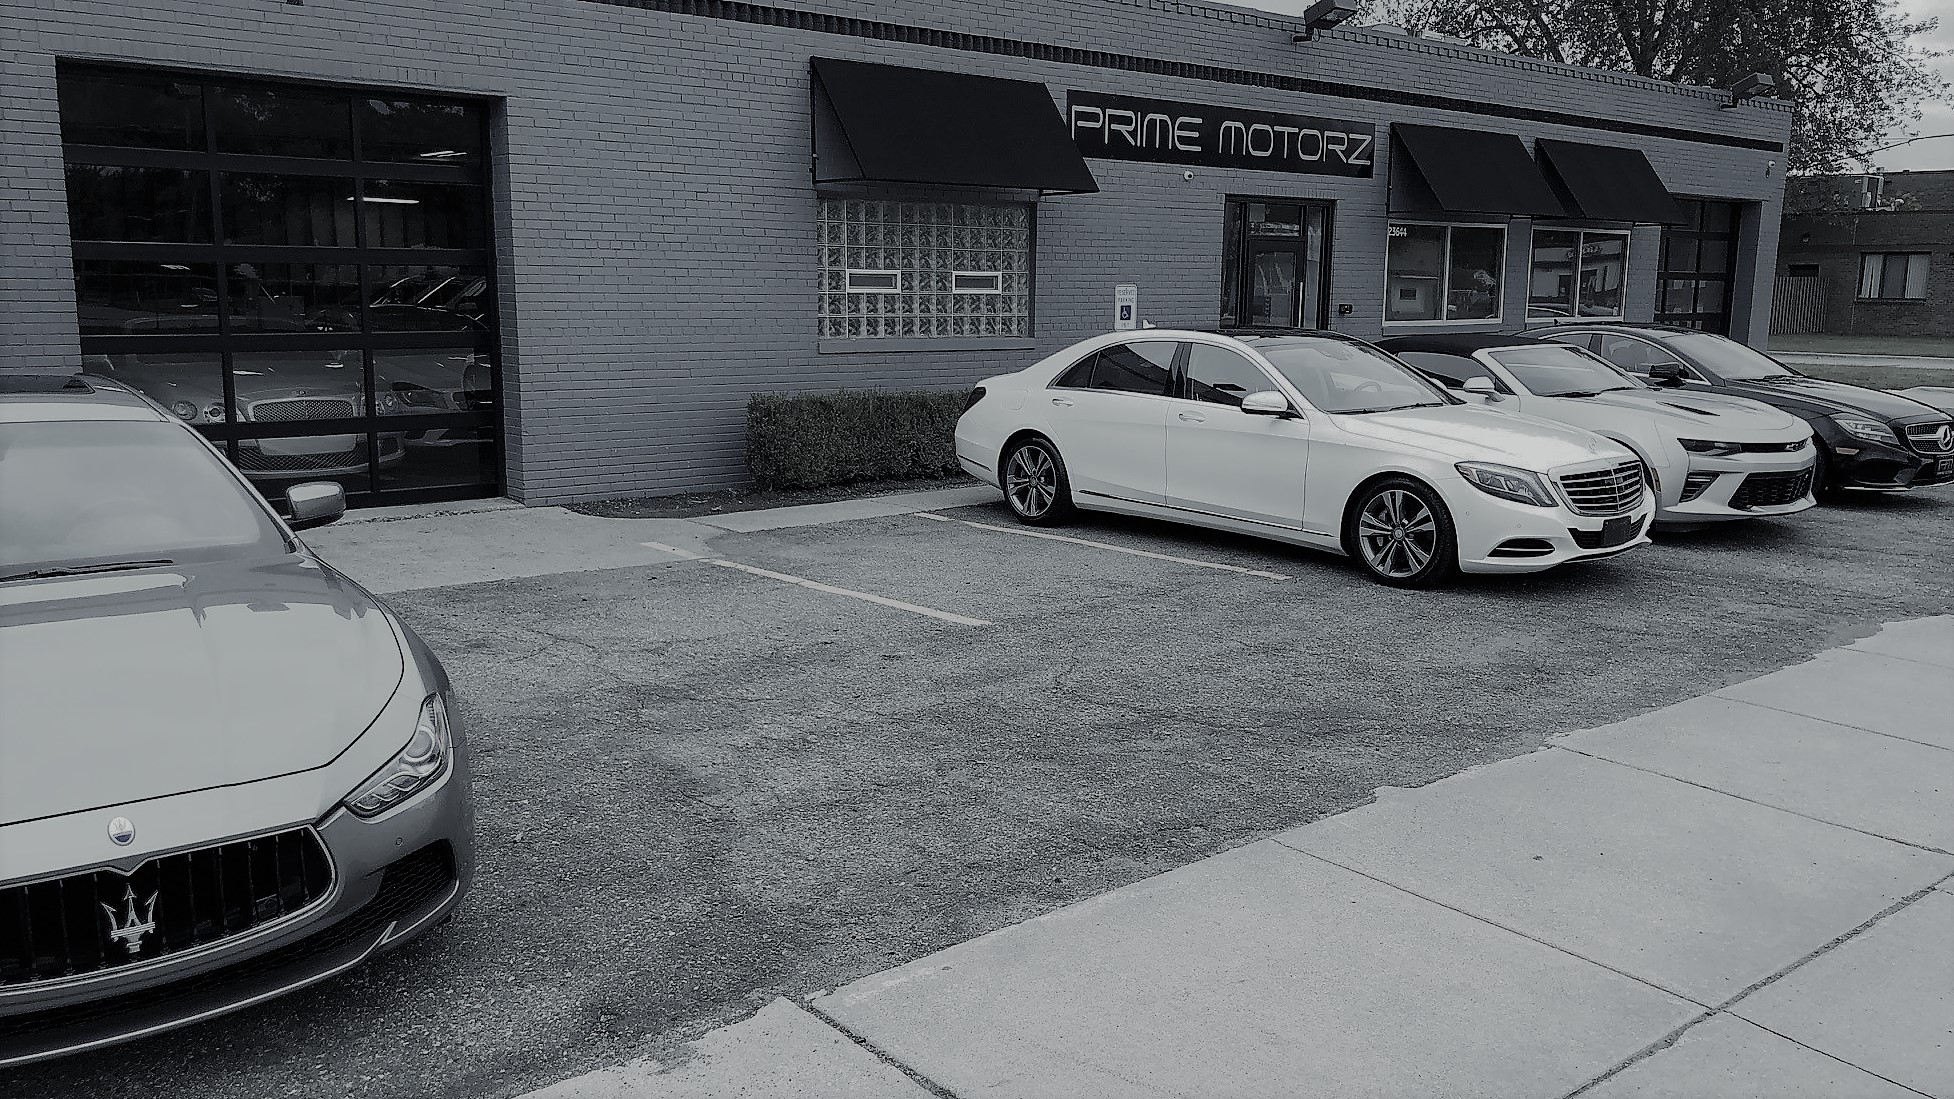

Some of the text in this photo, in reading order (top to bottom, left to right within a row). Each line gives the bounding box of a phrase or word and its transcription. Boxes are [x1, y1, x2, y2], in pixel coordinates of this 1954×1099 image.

[1072, 105, 1372, 166] PRIME MOTORZ
[1388, 226, 1408, 238] 23644
